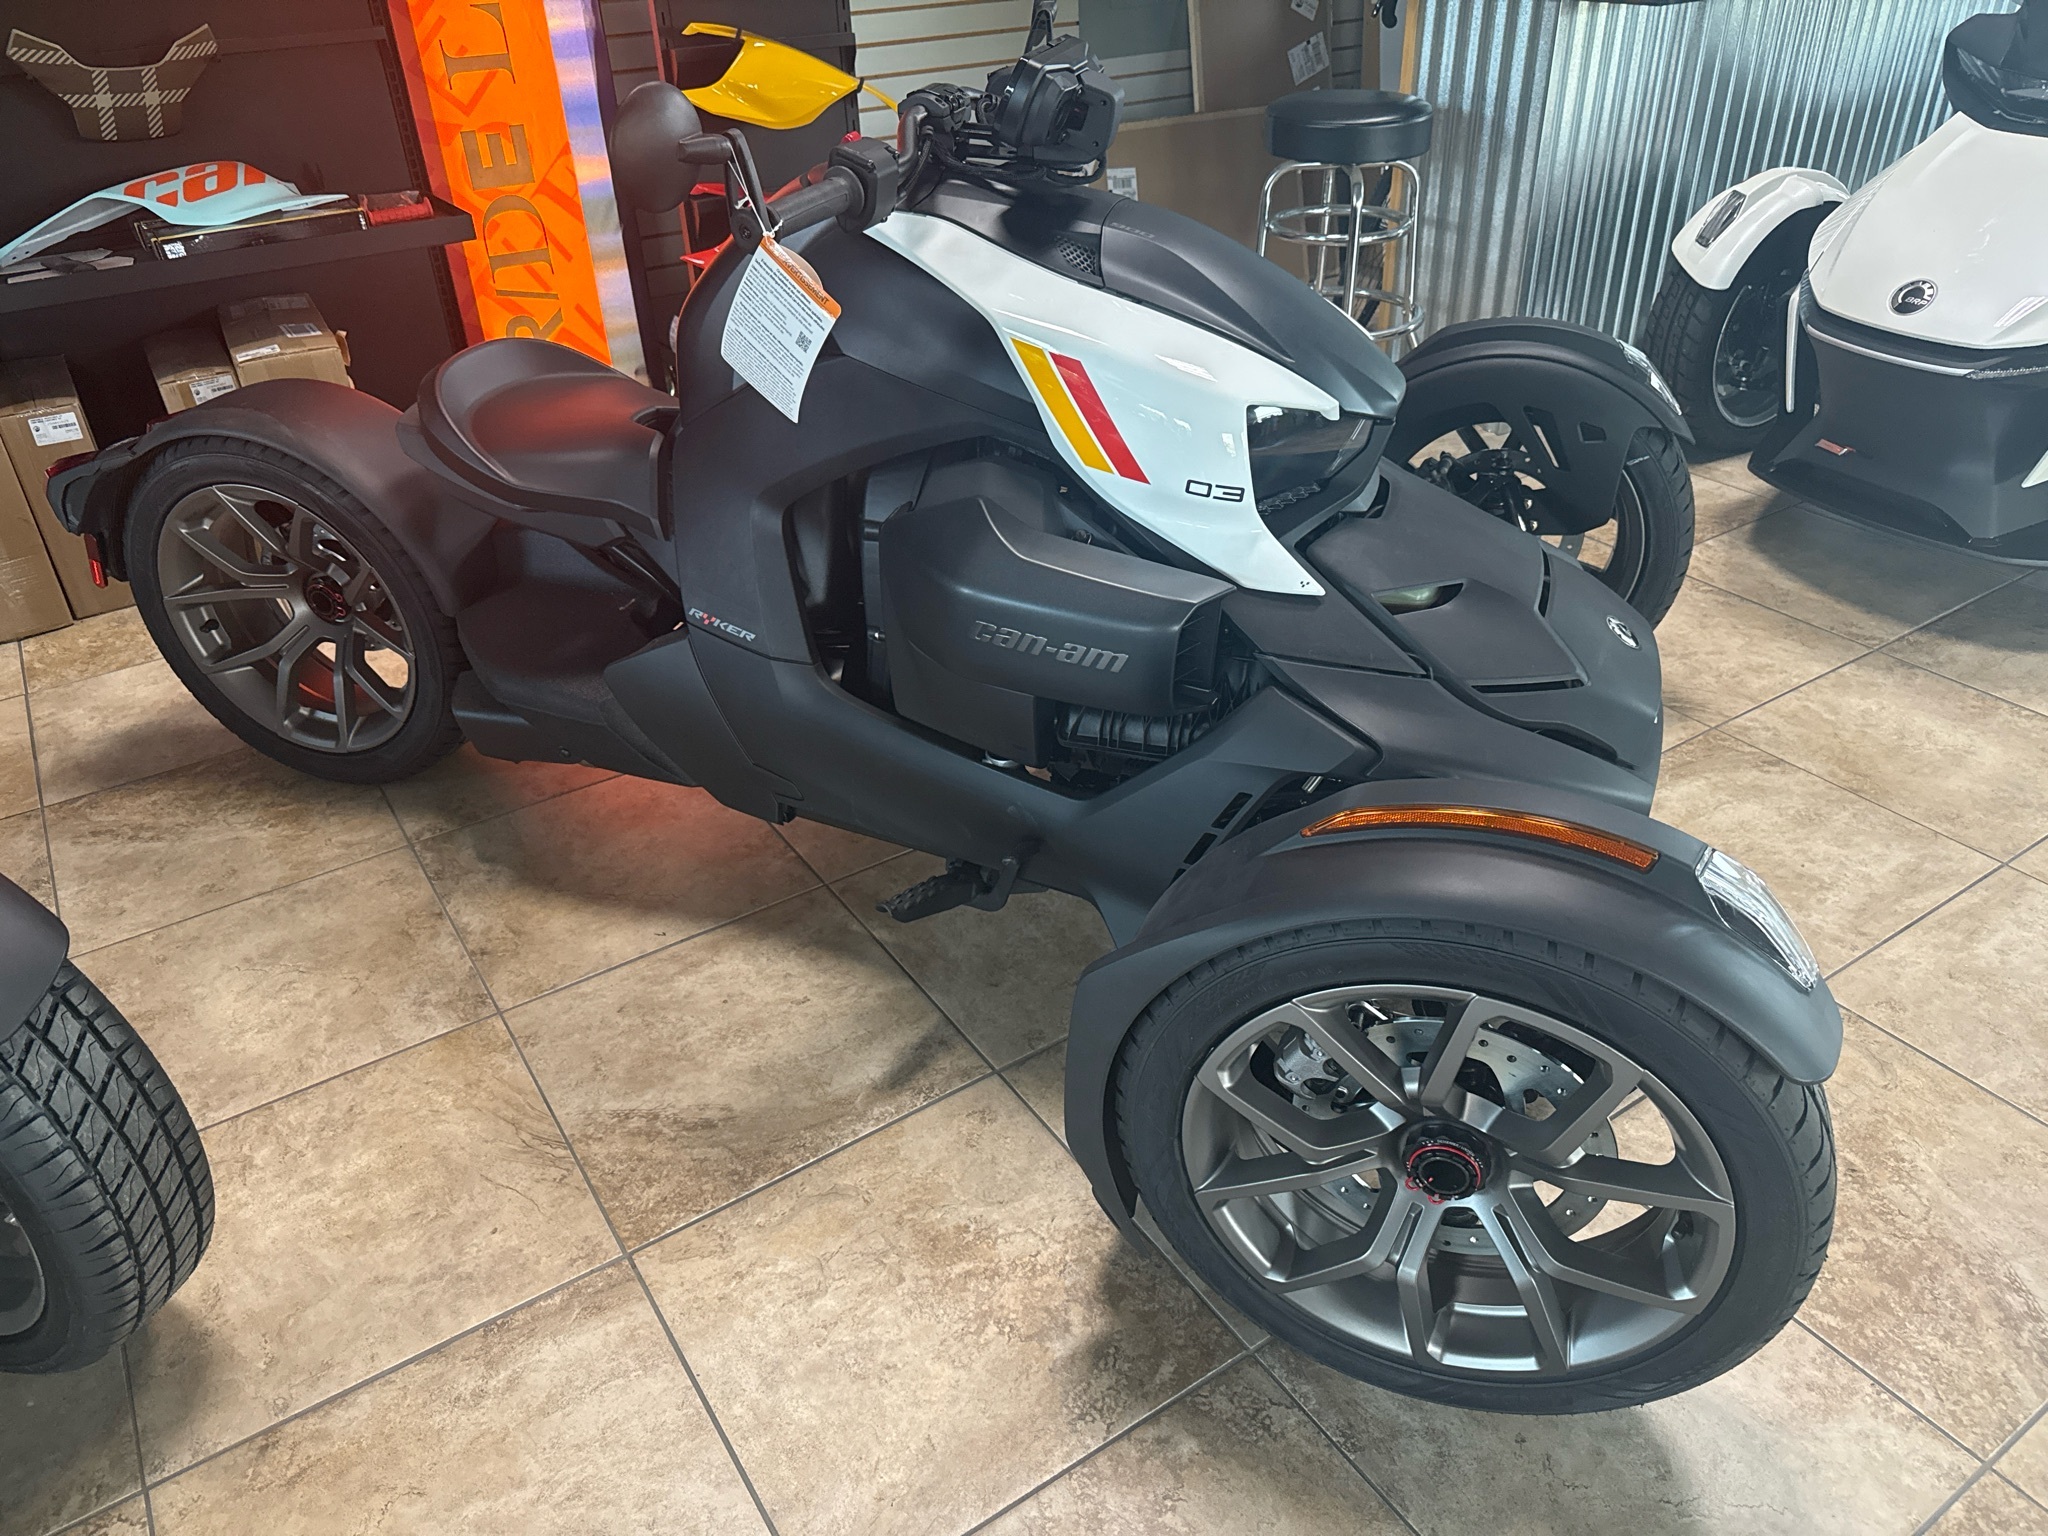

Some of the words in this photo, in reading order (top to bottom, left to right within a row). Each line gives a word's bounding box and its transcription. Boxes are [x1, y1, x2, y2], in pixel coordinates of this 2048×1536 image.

[1185, 479, 1245, 502] 03
[688, 607, 756, 642] RYKER
[970, 620, 1129, 673] can-am
